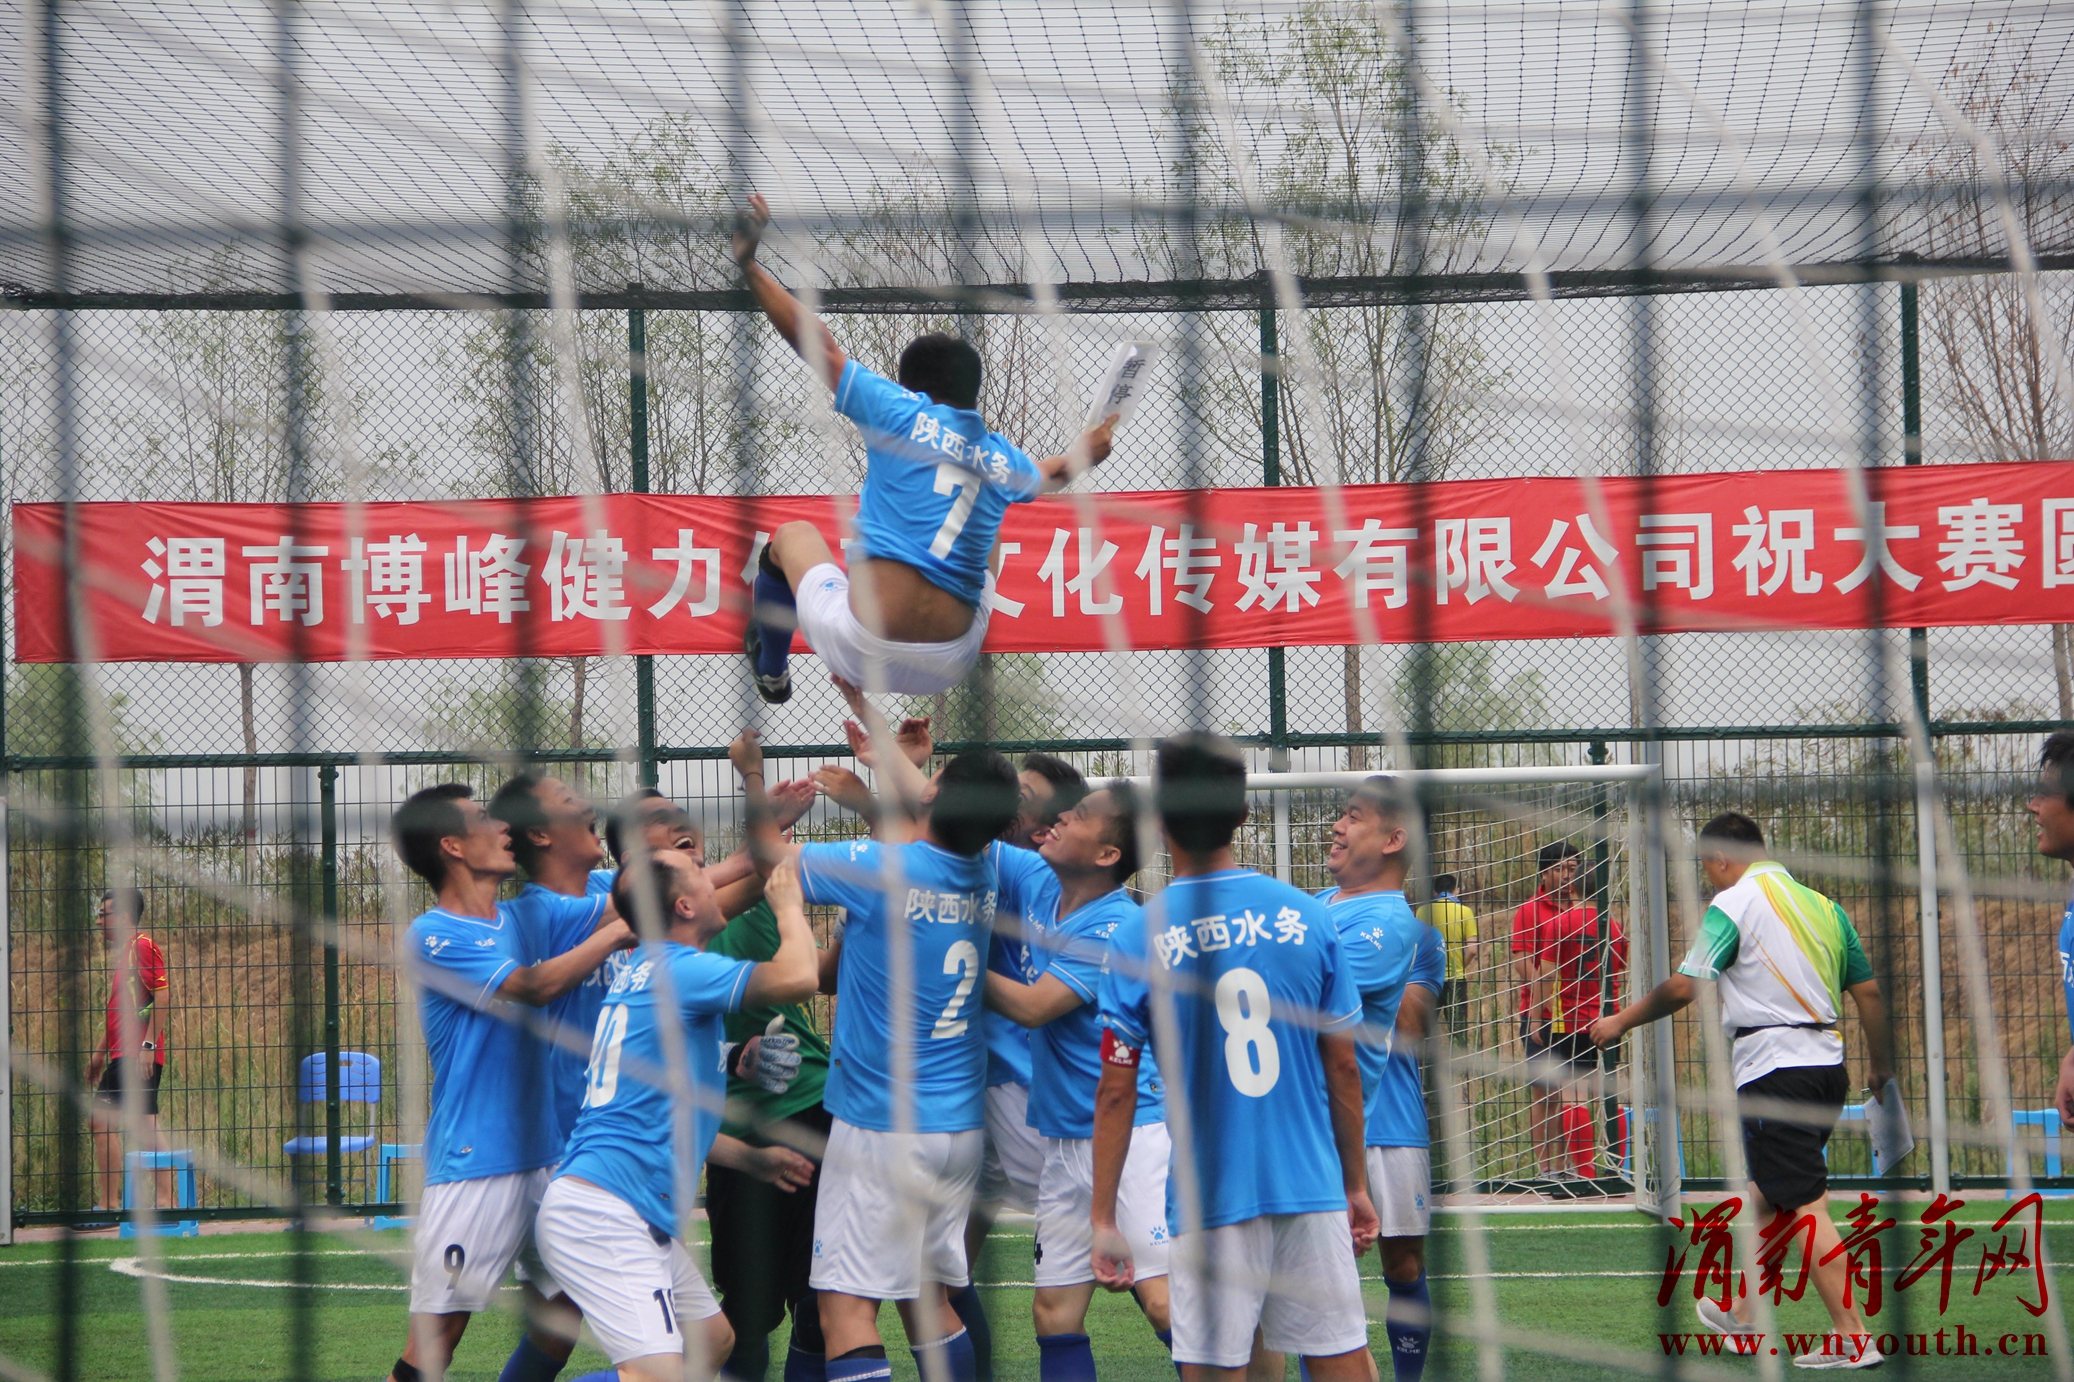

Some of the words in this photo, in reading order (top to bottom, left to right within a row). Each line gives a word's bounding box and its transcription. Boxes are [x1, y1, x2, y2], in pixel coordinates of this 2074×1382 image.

[1108, 357, 1147, 405] 暂停
[910, 411, 1011, 485] 陕西水务
[928, 461, 982, 561] 7
[904, 888, 998, 925] 陕西水务
[1153, 906, 1308, 971] 陕西水务
[1360, 931, 1383, 951] KELME
[930, 940, 979, 1038] 2
[1215, 967, 1280, 1098] 8
[1109, 1056, 1133, 1065] KELME
[444, 1243, 465, 1291] 9
[652, 1288, 677, 1335] 1
